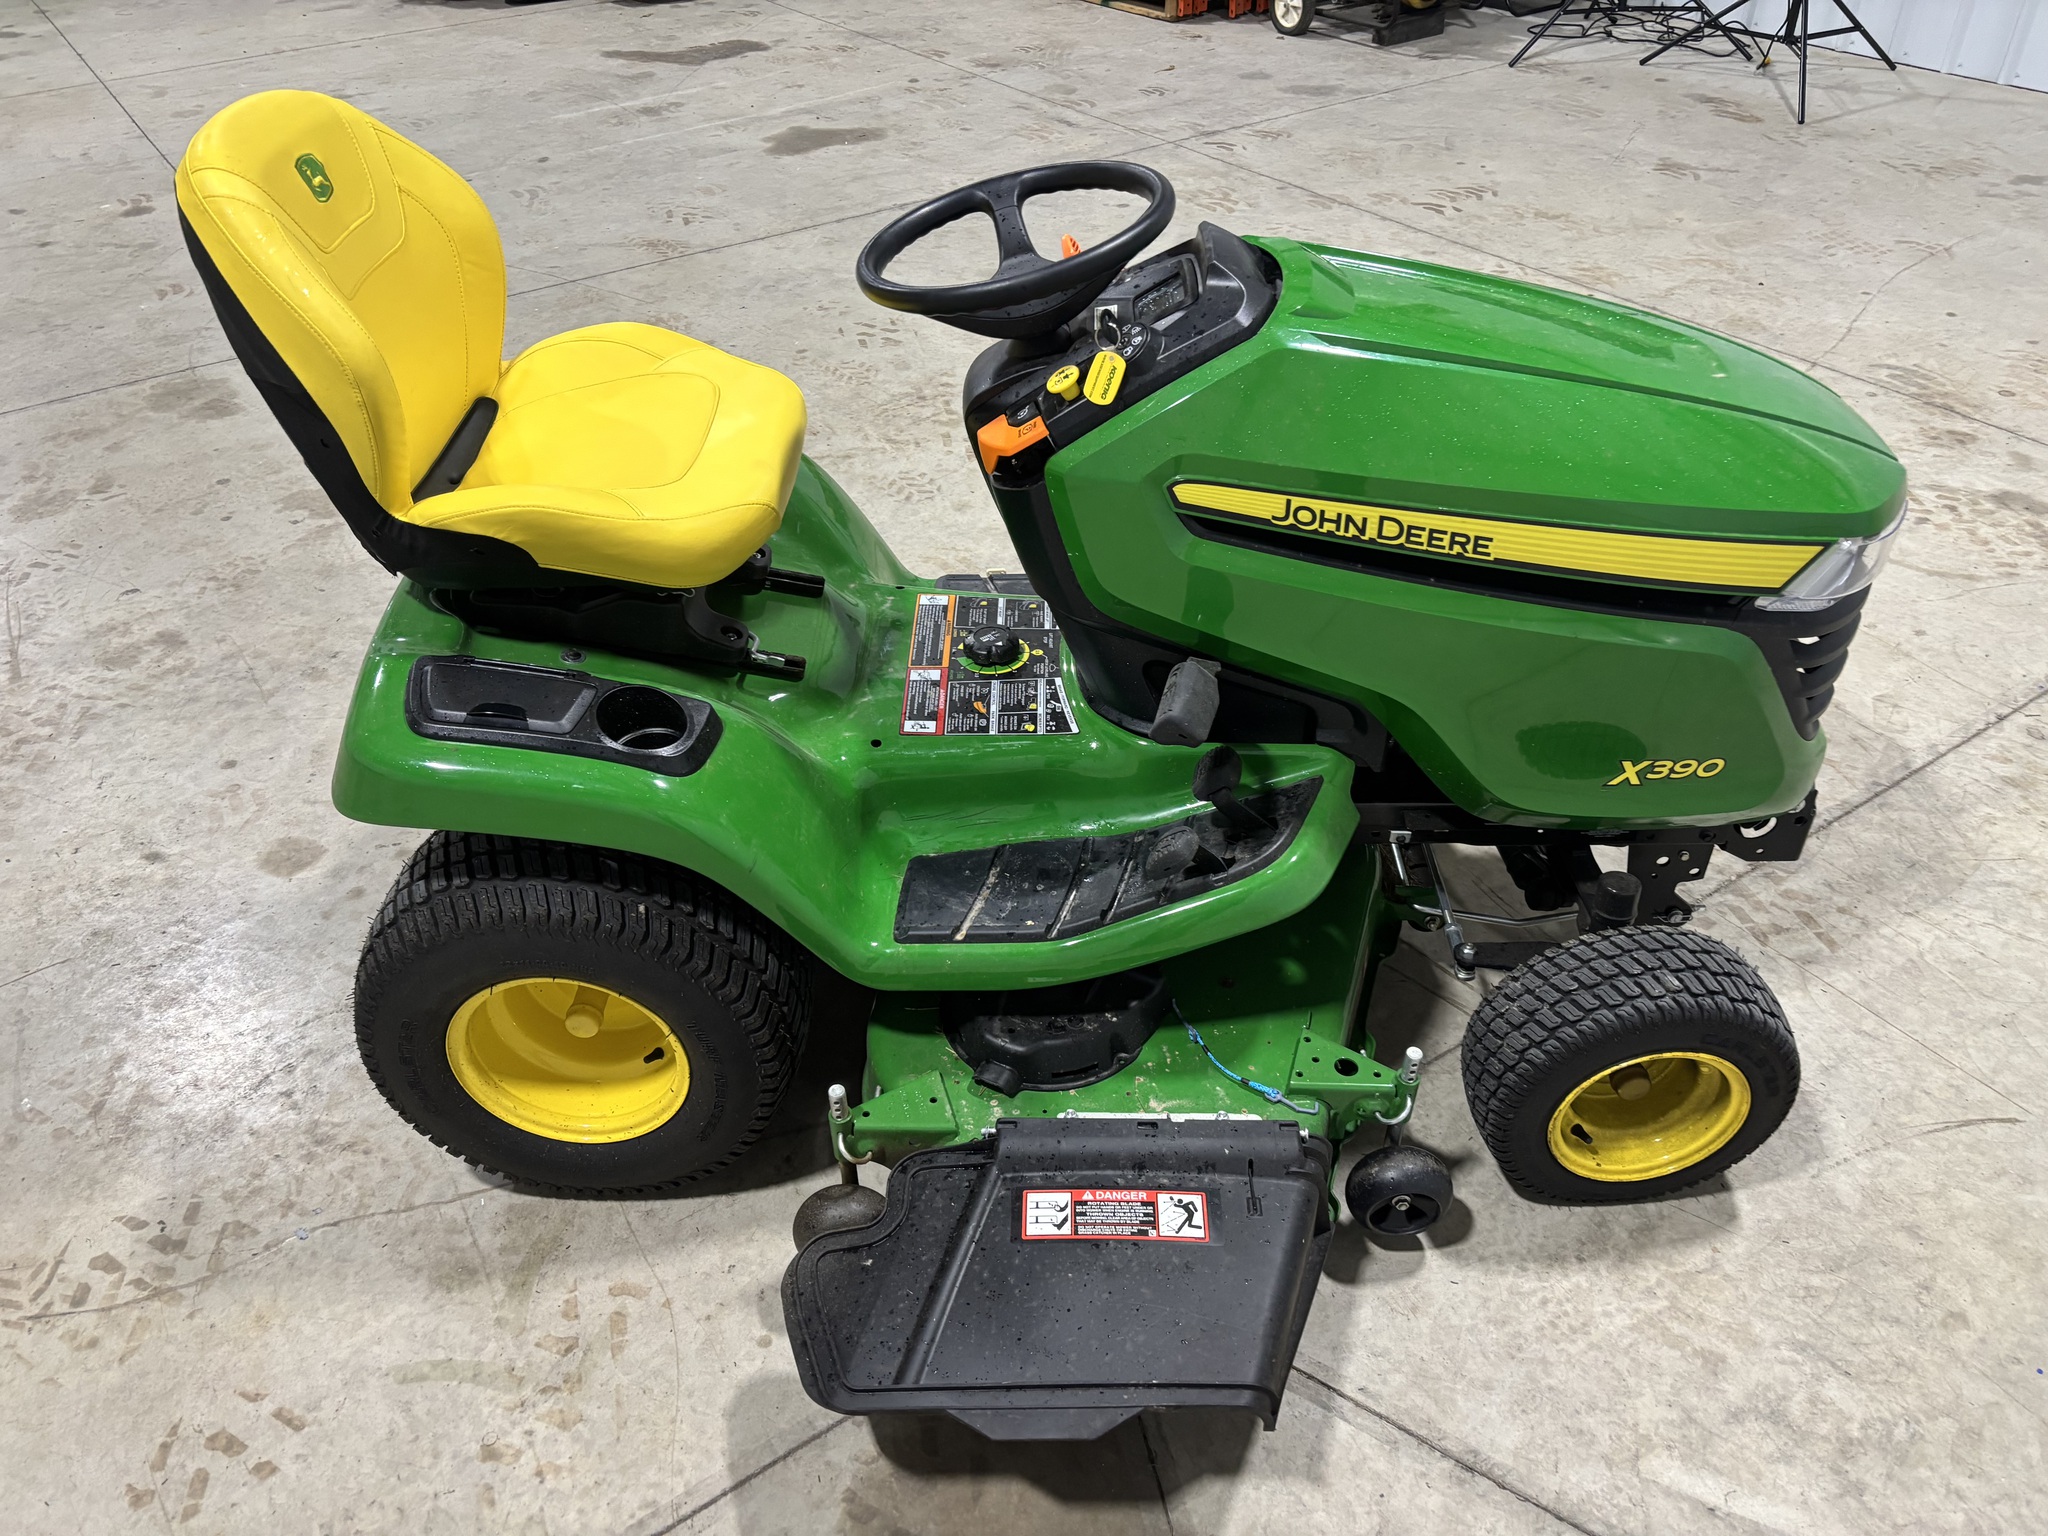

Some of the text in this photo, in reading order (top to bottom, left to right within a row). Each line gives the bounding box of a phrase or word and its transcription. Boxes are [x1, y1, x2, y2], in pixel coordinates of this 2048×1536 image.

[1271, 498, 1494, 557] JOHN DEERE
[1602, 757, 1726, 786] X390
[1095, 1191, 1147, 1200] DANGER
